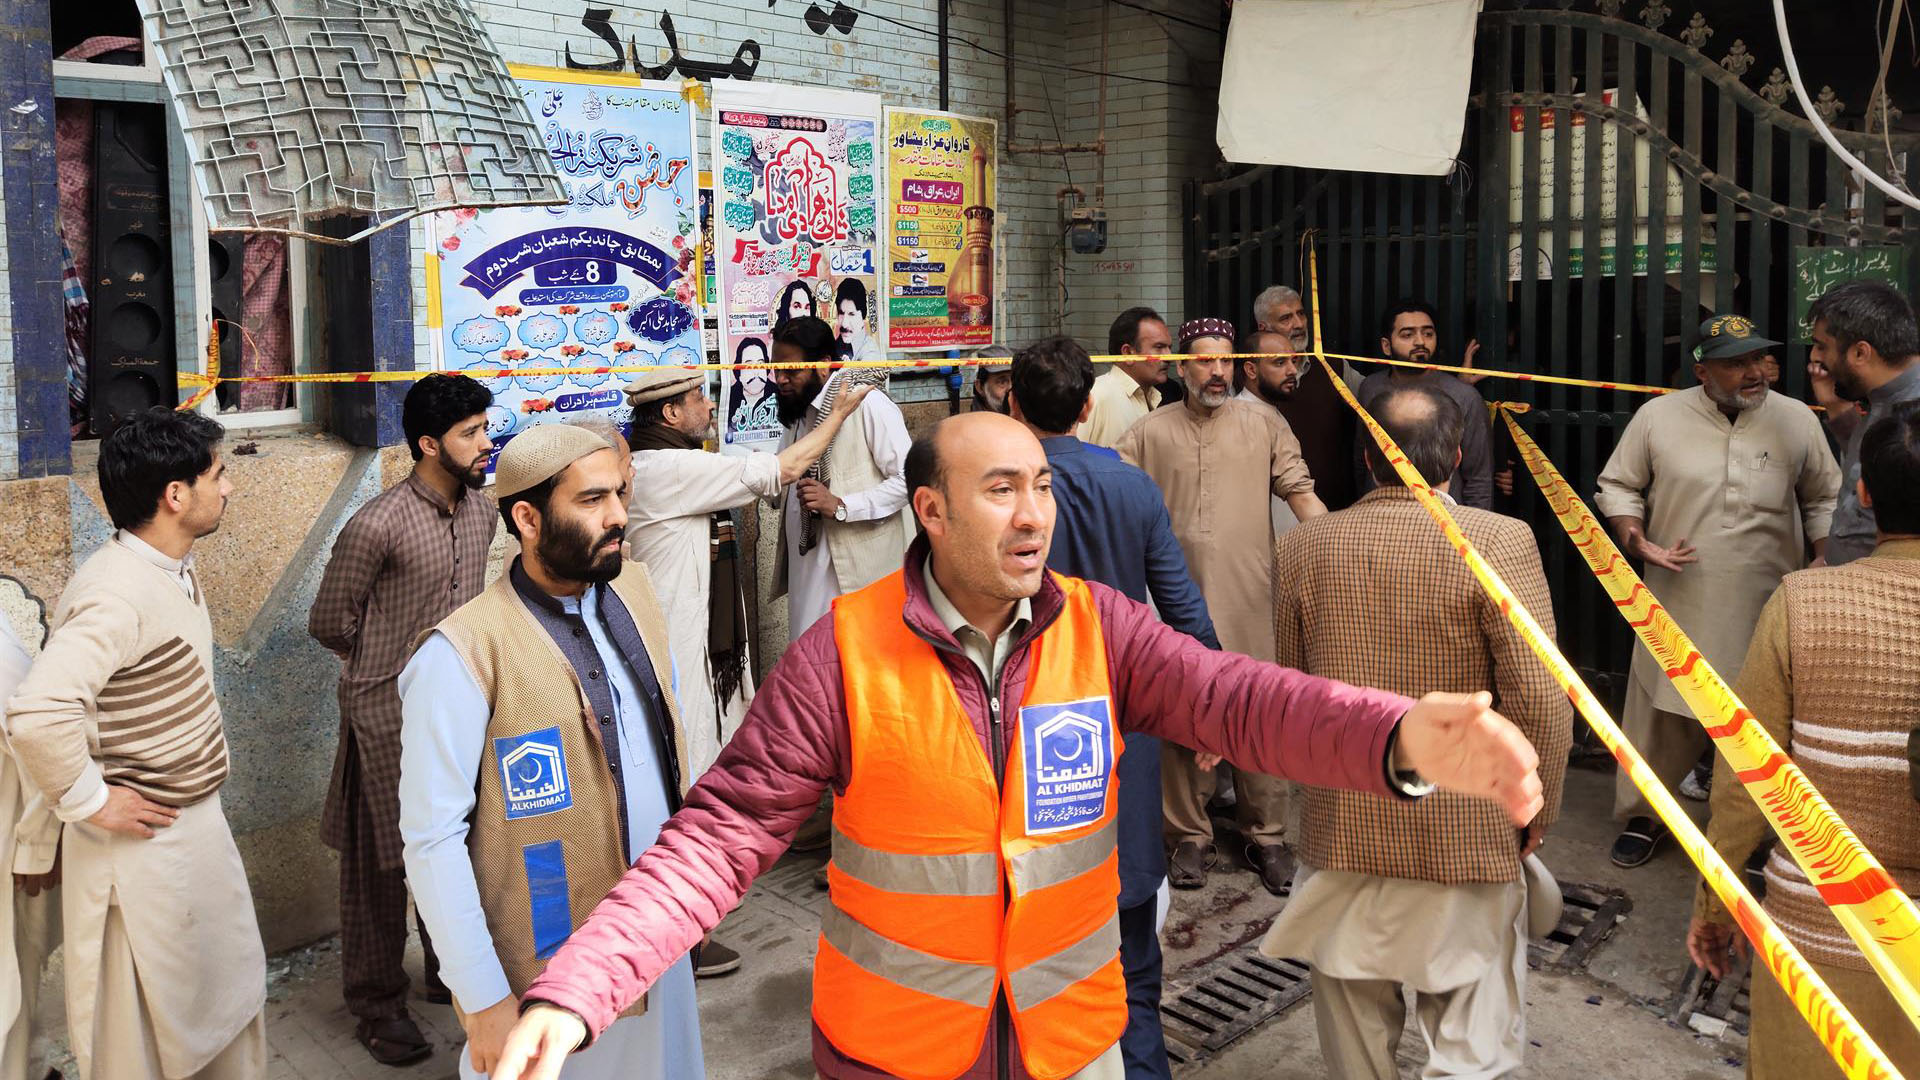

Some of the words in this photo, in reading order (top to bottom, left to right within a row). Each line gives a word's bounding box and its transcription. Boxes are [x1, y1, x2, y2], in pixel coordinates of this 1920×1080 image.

[893, 130, 923, 152] پشاور
[532, 233, 569, 254] شعبان
[620, 245, 662, 271] بمطابق
[485, 257, 508, 283] دوم
[586, 260, 600, 283] 8
[1036, 784, 1053, 796] AL
[1055, 778, 1104, 795] KHIDMAT
[511, 793, 567, 811] ALKHIDMAT
